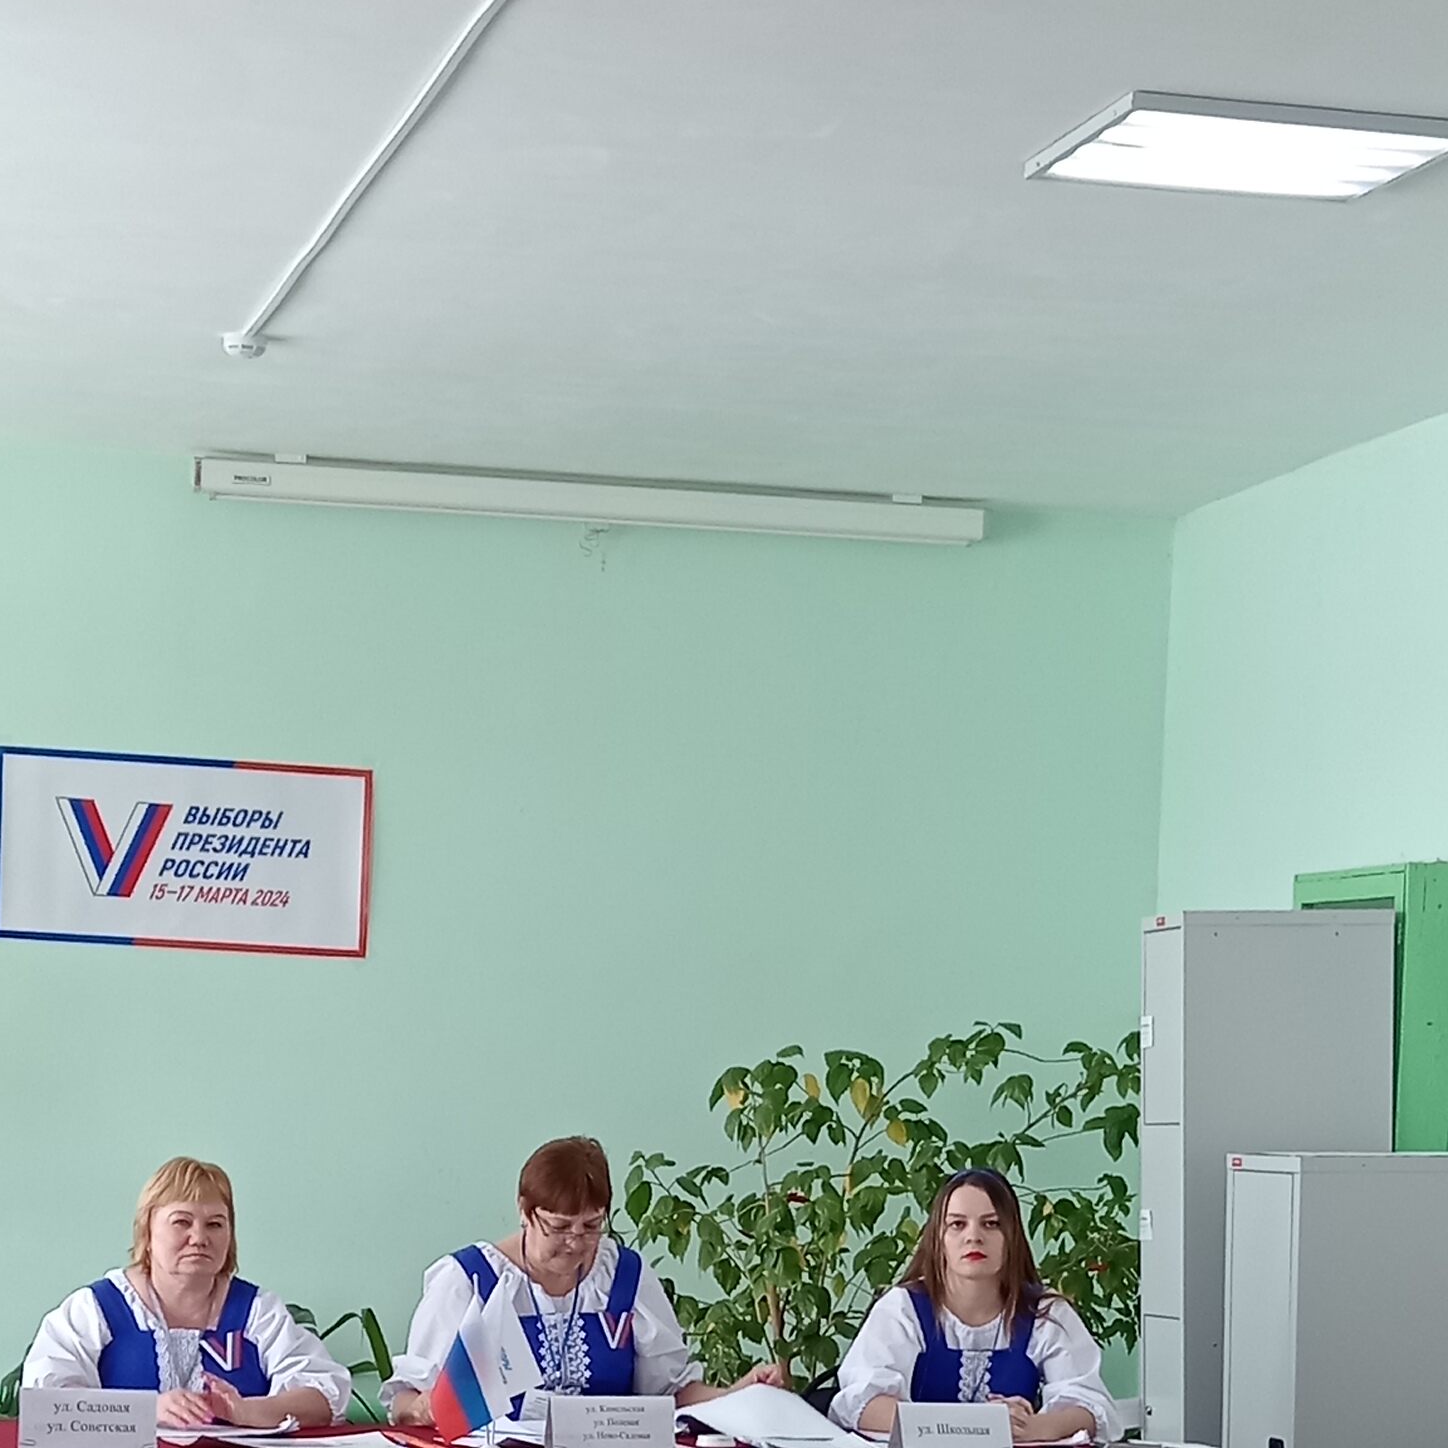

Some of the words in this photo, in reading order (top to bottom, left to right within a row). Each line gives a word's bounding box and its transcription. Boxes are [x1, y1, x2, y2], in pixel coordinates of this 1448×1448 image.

[182, 805, 284, 831] ВЫБОРЫ
[170, 831, 312, 859] ПРЕЗИДЕНТА
[158, 857, 251, 882] РОССИИ
[194, 886, 249, 906] МАРТА
[251, 889, 292, 908] 2024
[76, 1400, 130, 1414] Садовая
[46, 1421, 67, 1434] ул.
[70, 1419, 136, 1433] Советская
[936, 1423, 990, 1436] Школьная
